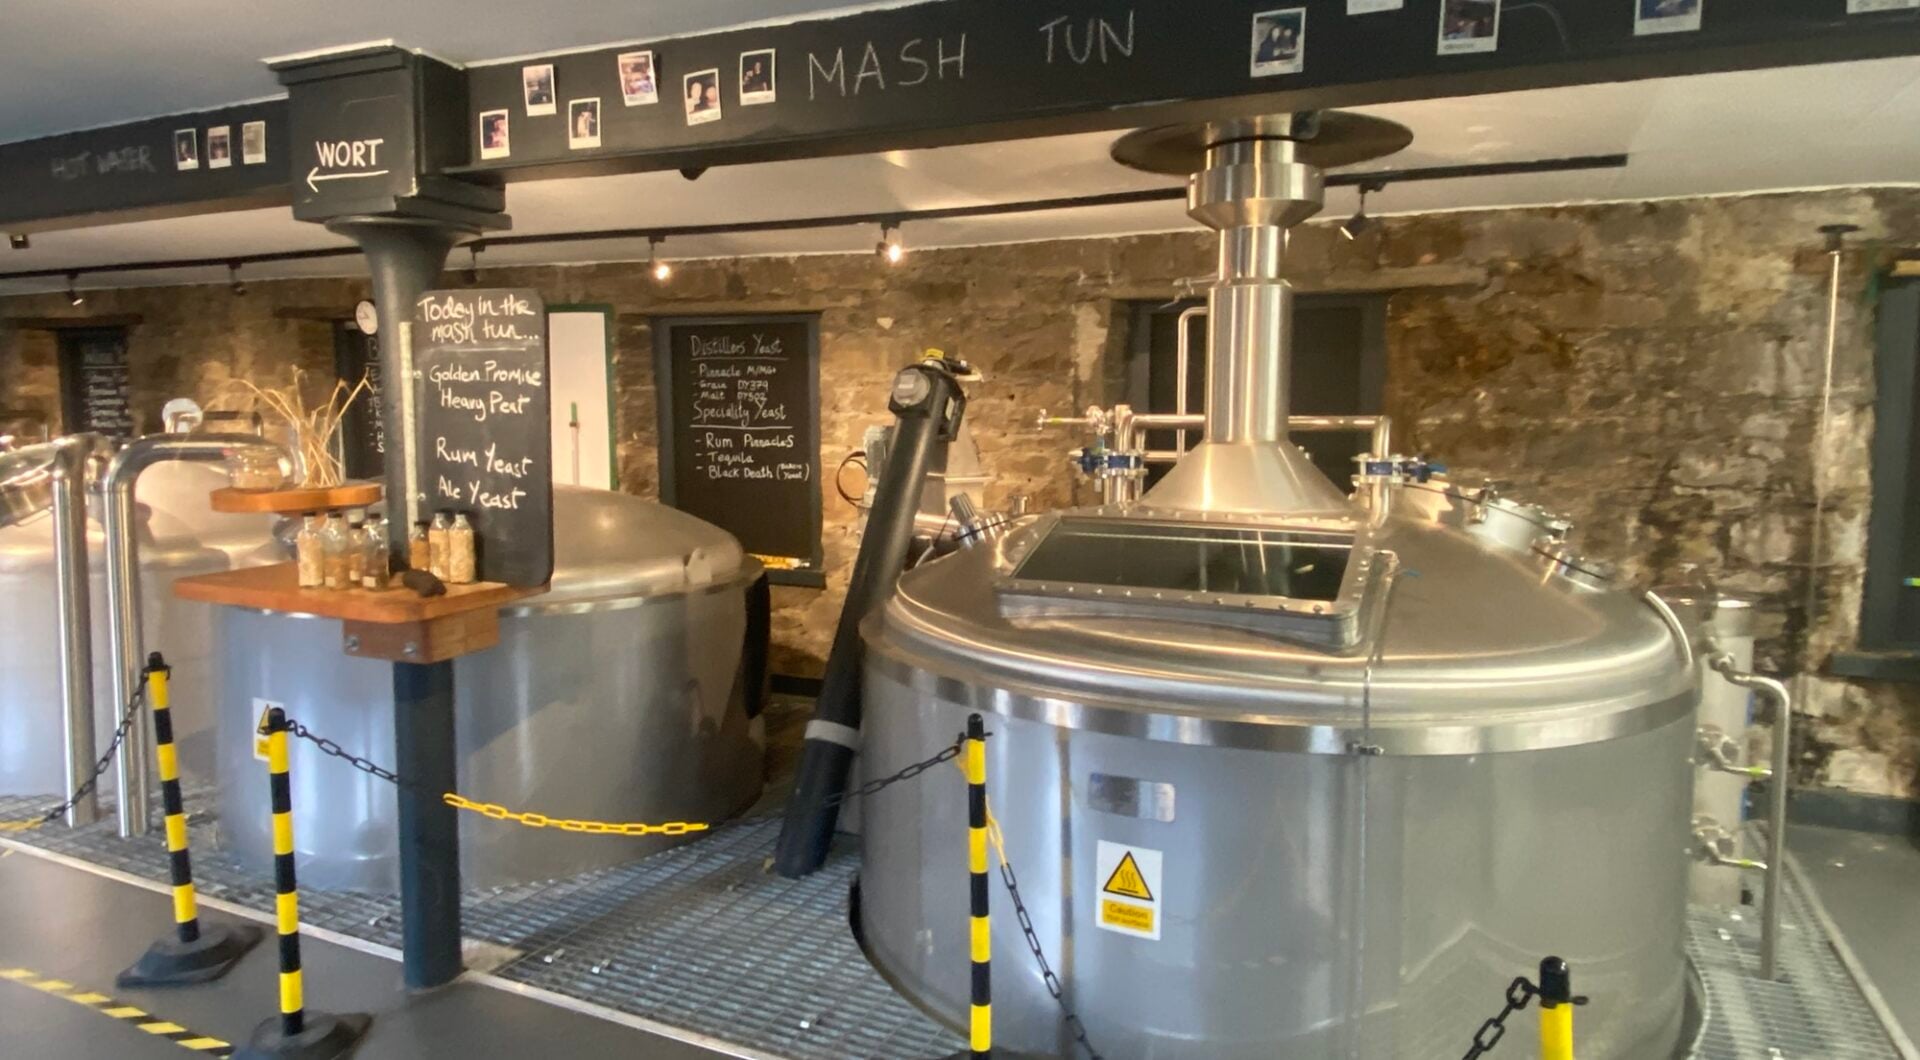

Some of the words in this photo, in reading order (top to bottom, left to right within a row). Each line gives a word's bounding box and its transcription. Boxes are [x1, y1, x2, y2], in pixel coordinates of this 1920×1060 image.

[808, 33, 966, 100] MASH
[1039, 10, 1135, 64] TUN
[315, 138, 384, 168] WORT
[417, 295, 474, 326] Today
[478, 296, 498, 316] in
[500, 294, 535, 316] the
[690, 335, 745, 356] Distillers
[753, 334, 782, 354] Yeast
[429, 363, 480, 390] Golden
[484, 360, 541, 386] Promise
[699, 363, 740, 377] Pinnacle
[700, 380, 727, 389] Grain
[700, 391, 725, 400] Malt
[441, 387, 486, 421] Heavy
[490, 391, 530, 414] Peat
[692, 400, 749, 427] Speciality
[754, 399, 786, 420] Yeast
[705, 432, 733, 448] Rum
[436, 436, 478, 466] Rum
[485, 442, 533, 478] Yeast
[707, 451, 754, 466] Tequila
[708, 464, 740, 479] Black
[743, 465, 773, 479] Death
[438, 475, 461, 499] Ale
[469, 480, 526, 509] Yeast
